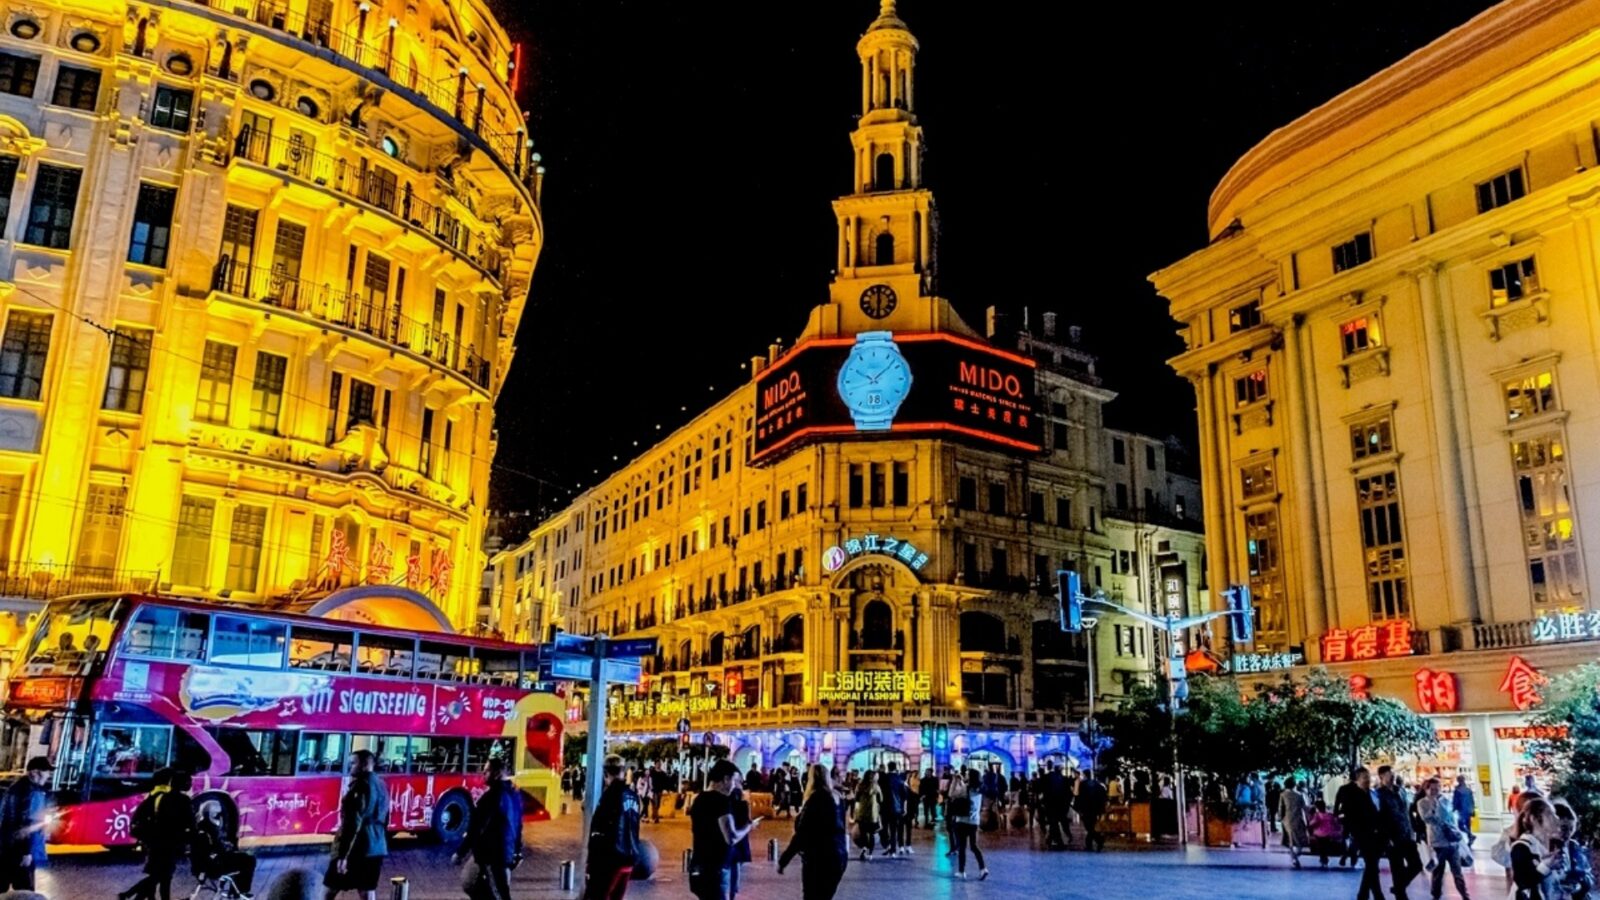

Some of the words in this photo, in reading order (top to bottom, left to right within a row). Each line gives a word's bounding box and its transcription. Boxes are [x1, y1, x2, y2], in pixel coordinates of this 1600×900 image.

[1323, 620, 1412, 662] 肯德基
[818, 671, 931, 691] 上海时装商店
[338, 688, 427, 717] SIGHTSEEING
[482, 697, 516, 709] HOP-ON
[818, 691, 861, 701] SHANGHAI
[863, 691, 900, 701] FASHION
[266, 794, 308, 811] Shanghai
